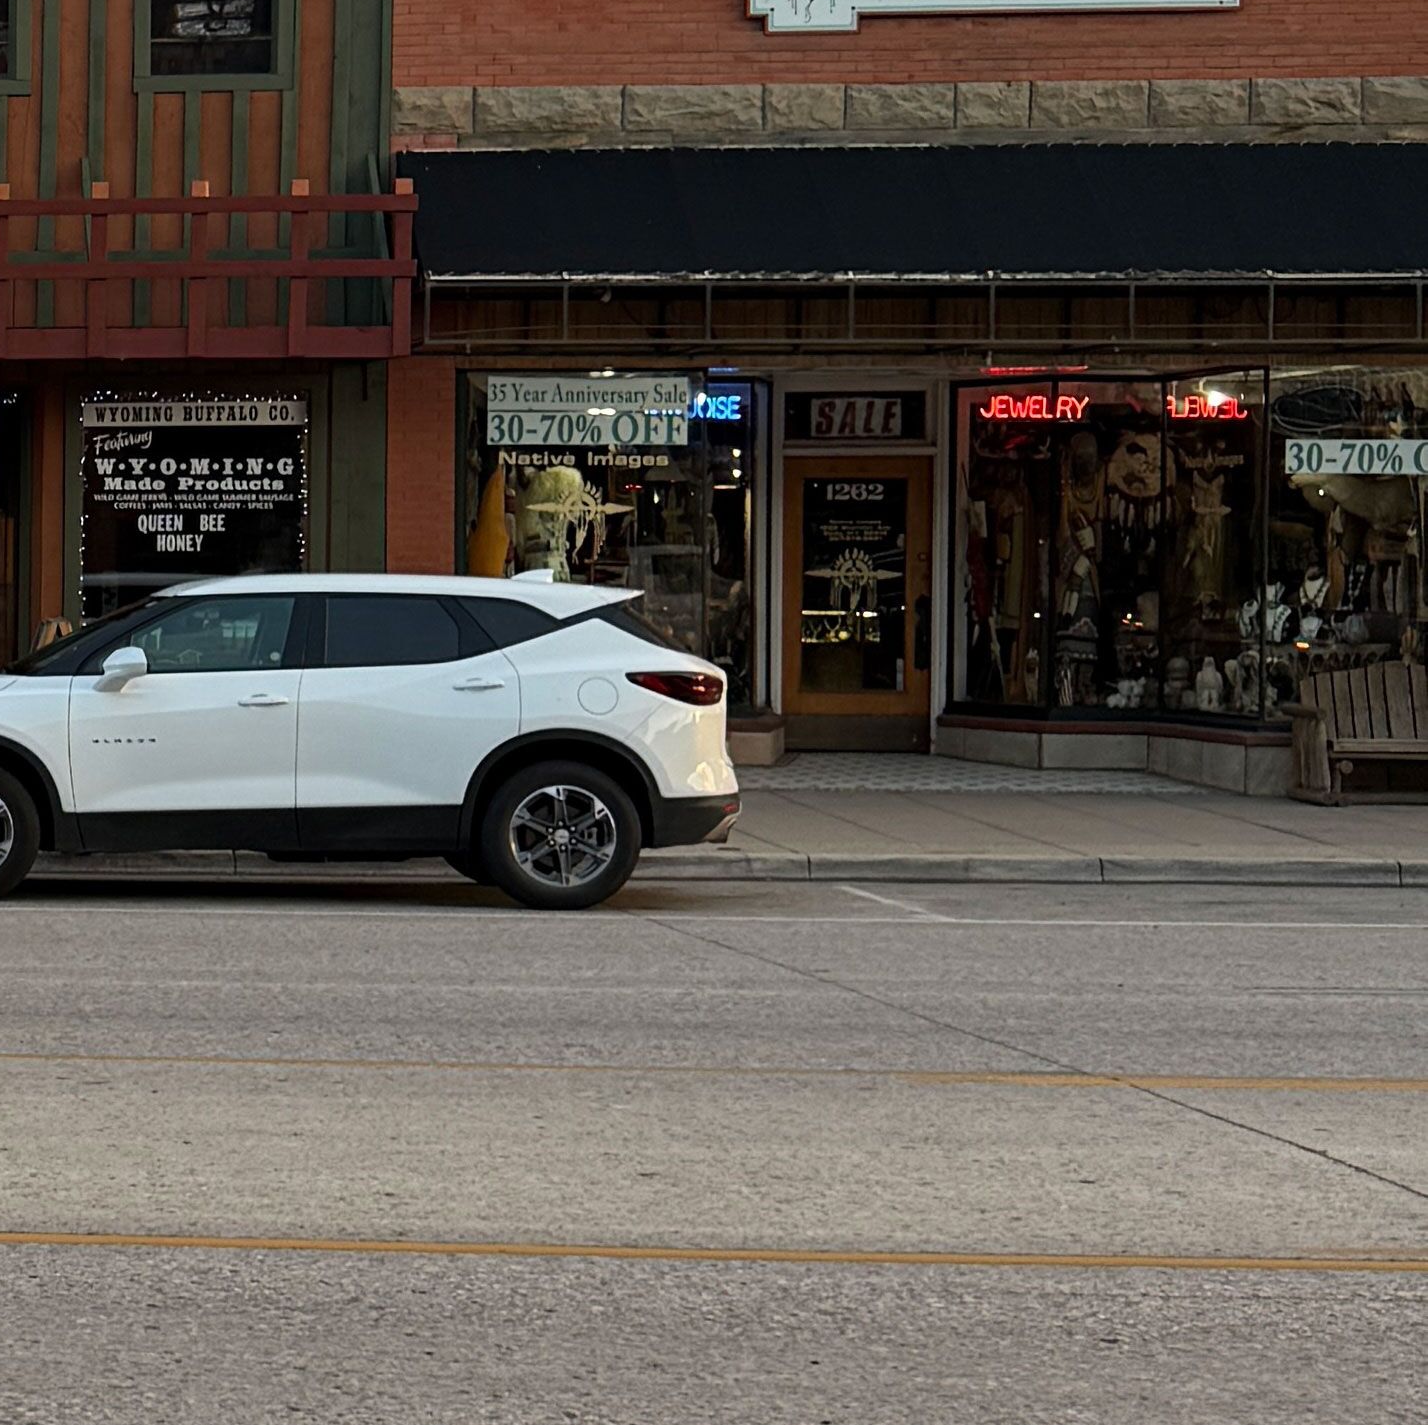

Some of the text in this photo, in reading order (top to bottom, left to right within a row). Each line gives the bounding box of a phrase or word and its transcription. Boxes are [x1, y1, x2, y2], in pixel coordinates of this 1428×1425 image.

[489, 383, 687, 408] 35 Year Anniversary Sale
[95, 405, 294, 422] WYOMING BUFFALO CO.
[815, 400, 898, 435] SALE
[980, 395, 1090, 419] JEWELRY
[490, 413, 687, 444] 30-70% OFF
[93, 430, 153, 455] Featuring
[498, 450, 669, 468] Native Images
[1288, 442, 1403, 473] 30-70%
[104, 477, 284, 490] Made Products
[826, 483, 884, 501] 1262
[138, 514, 226, 533] QUEEN BEE
[156, 534, 204, 552] HONEY
